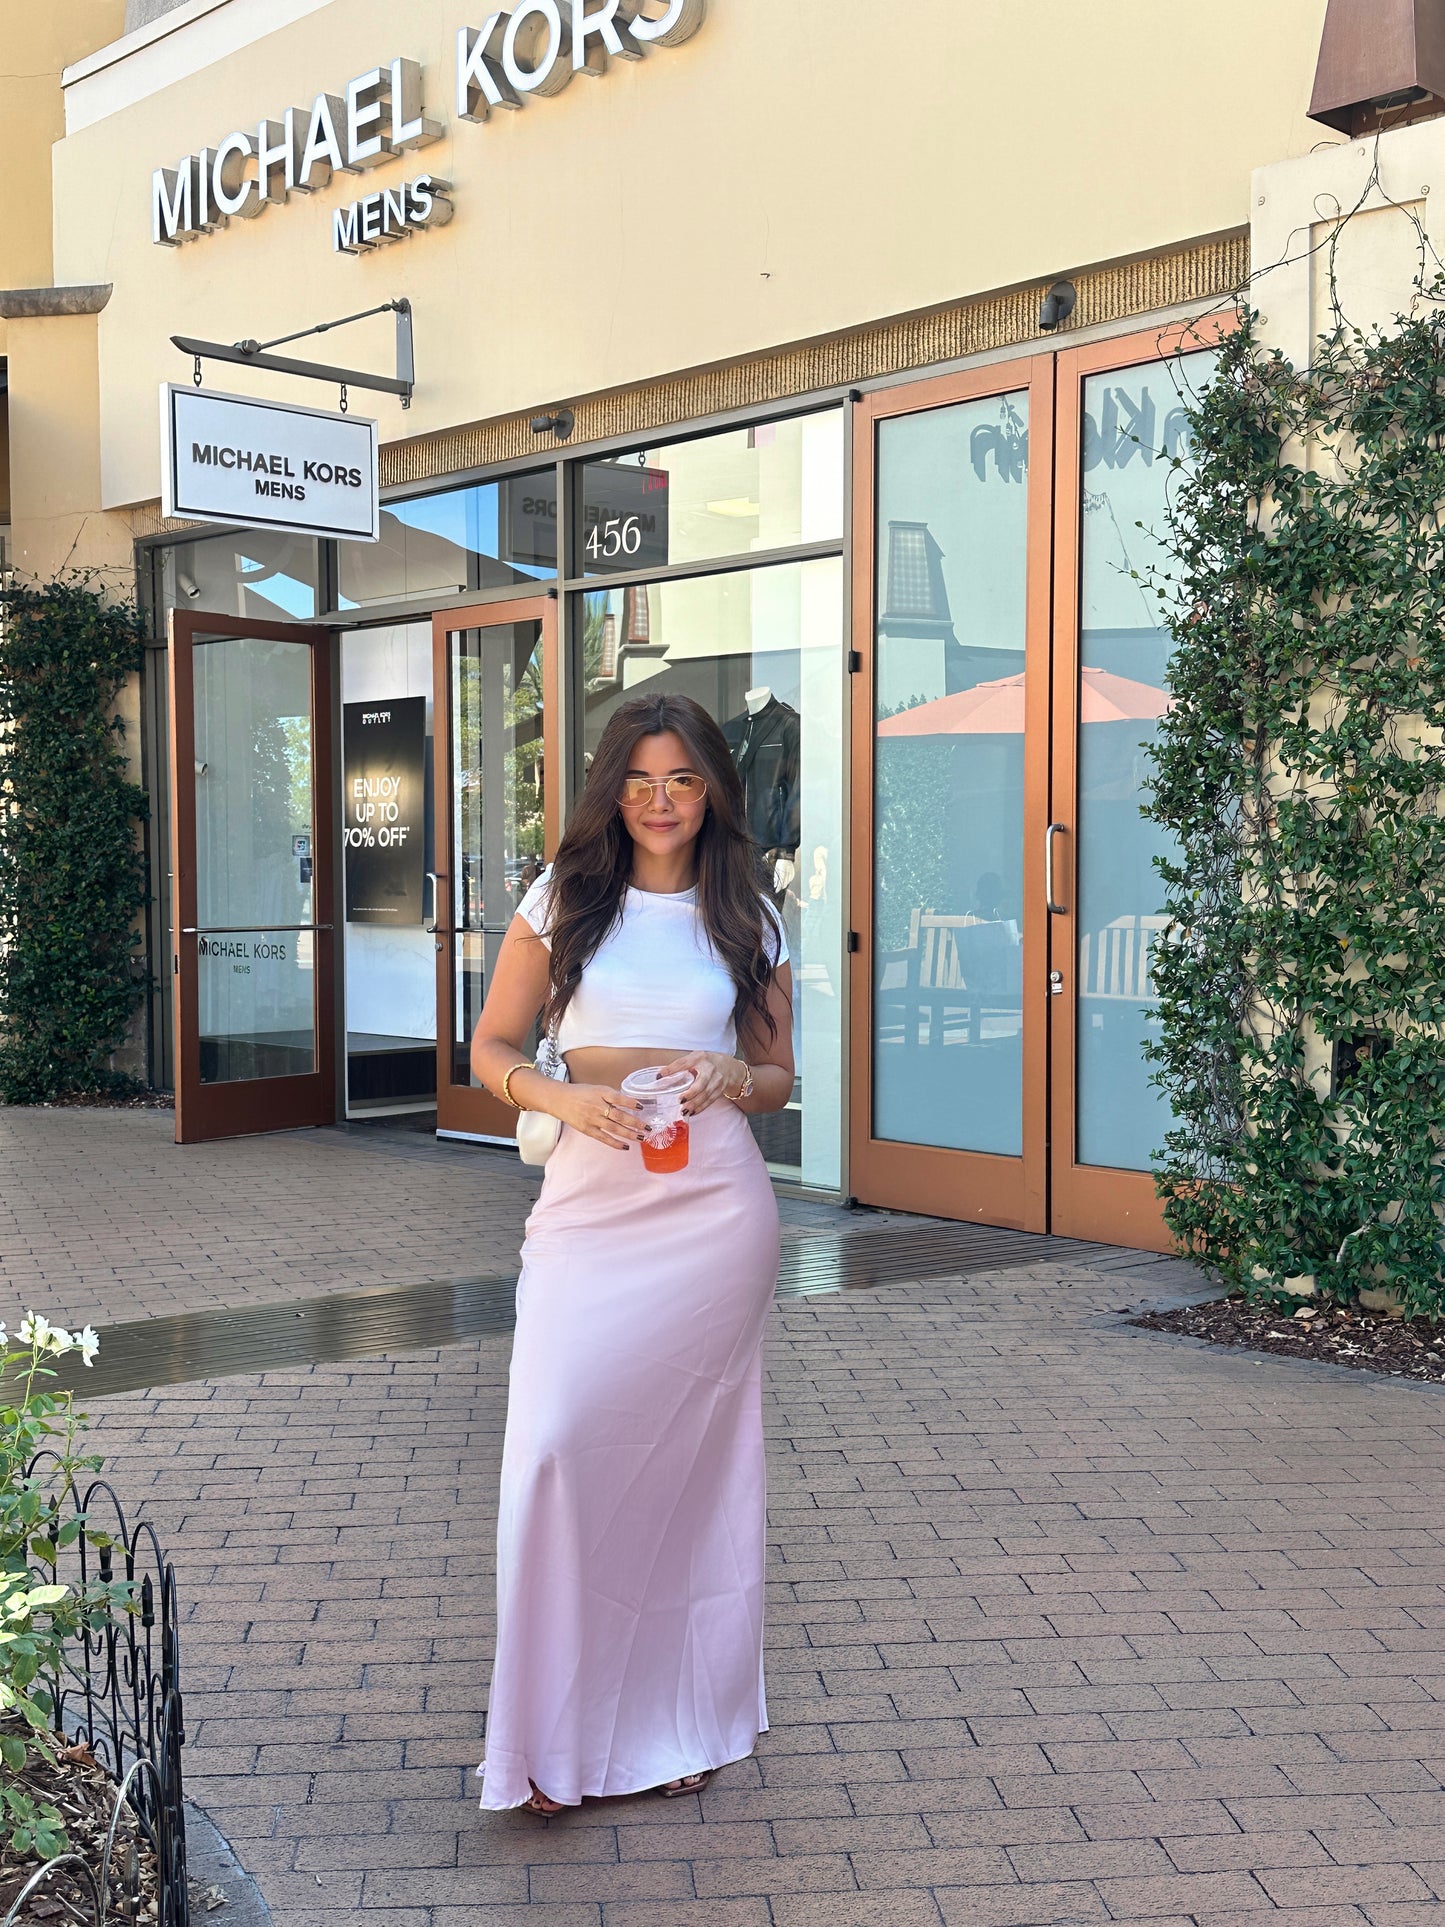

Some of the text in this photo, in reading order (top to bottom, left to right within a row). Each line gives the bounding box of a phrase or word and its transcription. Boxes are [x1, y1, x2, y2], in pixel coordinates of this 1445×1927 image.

[152, 57, 423, 245] MICHAEL
[333, 174, 433, 253] MENS
[192, 442, 362, 488] MICHAEL KORS
[255, 479, 306, 501] MENS
[585, 516, 642, 559] 456
[353, 776, 401, 798] ENJOY
[355, 801, 399, 823] UP TO
[198, 940, 287, 961] MICHAEL KORS
